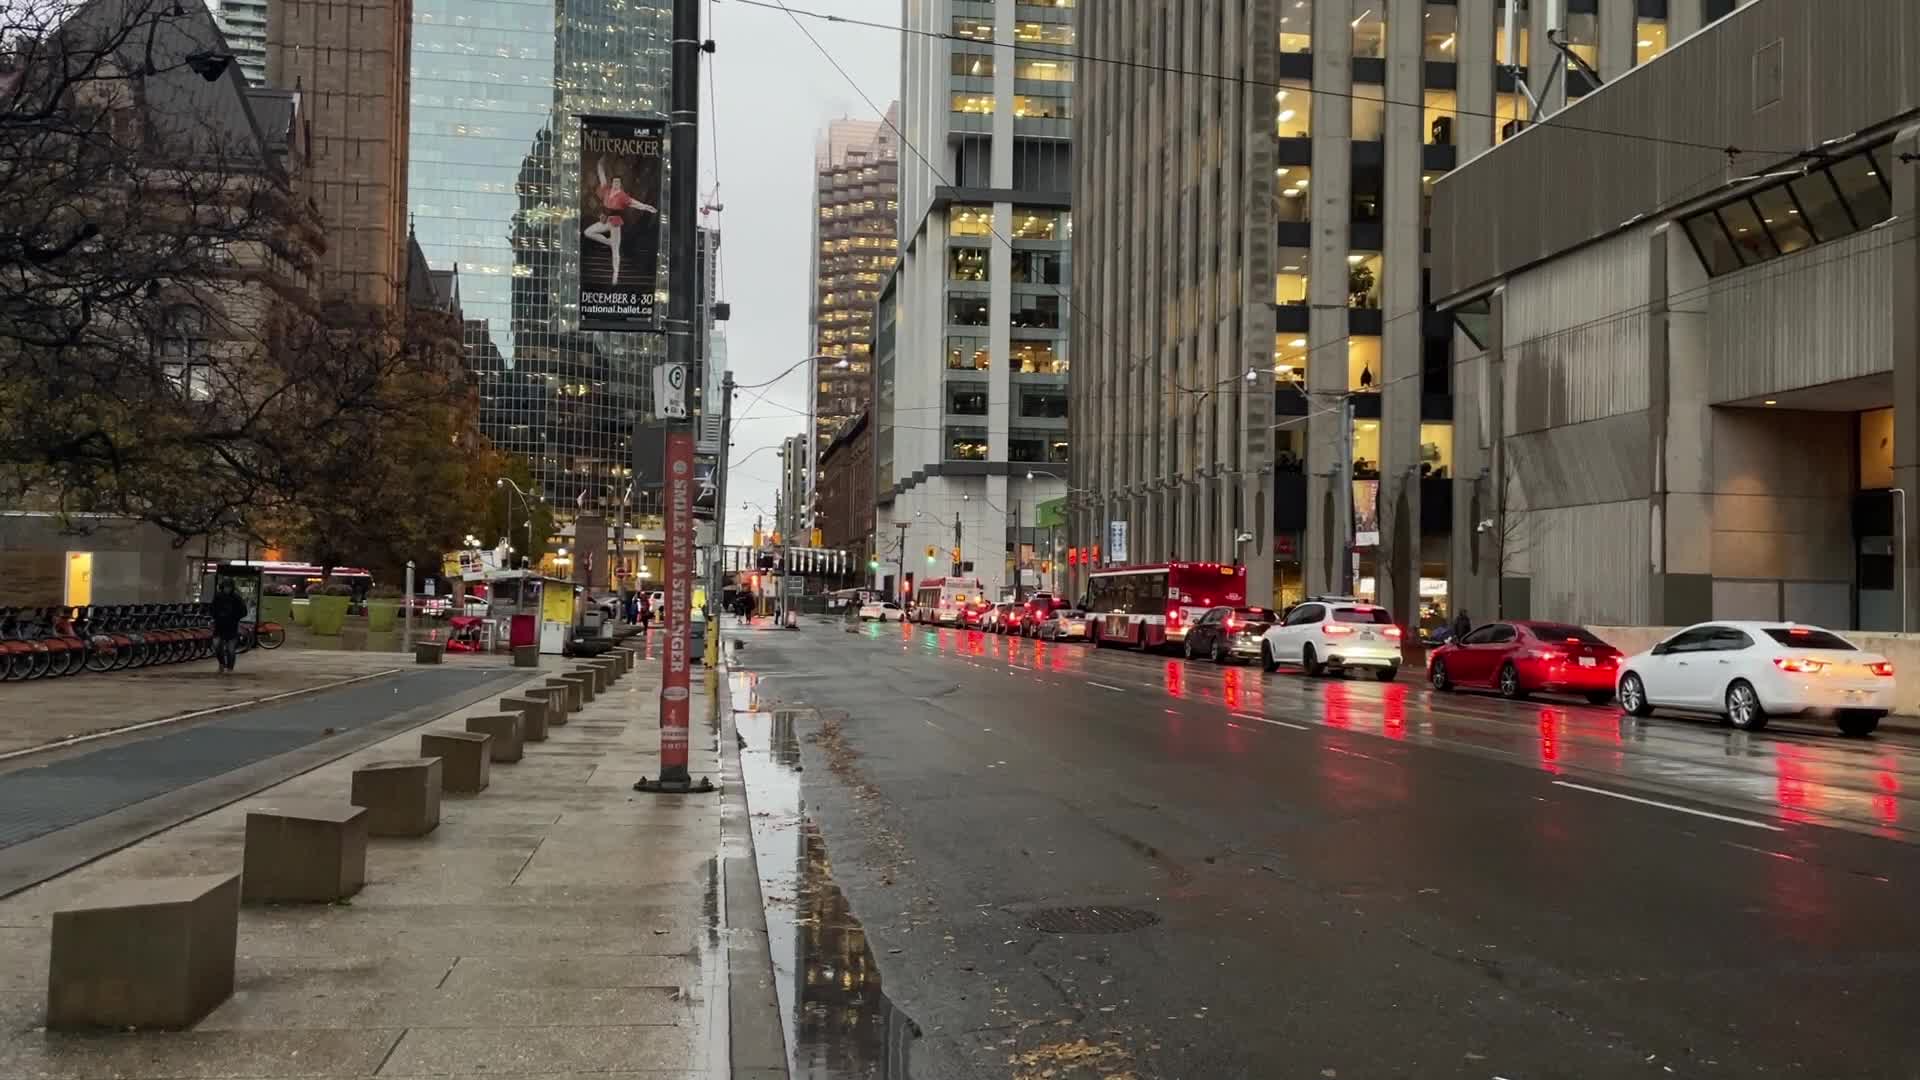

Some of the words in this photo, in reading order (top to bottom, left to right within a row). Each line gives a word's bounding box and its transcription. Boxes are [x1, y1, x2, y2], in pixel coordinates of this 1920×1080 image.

[583, 131, 659, 156] NUTCRACKER
[582, 291, 629, 304] DECEMBER
[581, 305, 653, 314] national.ballet.ca
[673, 479, 688, 531] SMILE
[673, 535, 686, 558] AT
[673, 563, 686, 574] A
[671, 580, 686, 672] STRANGER
